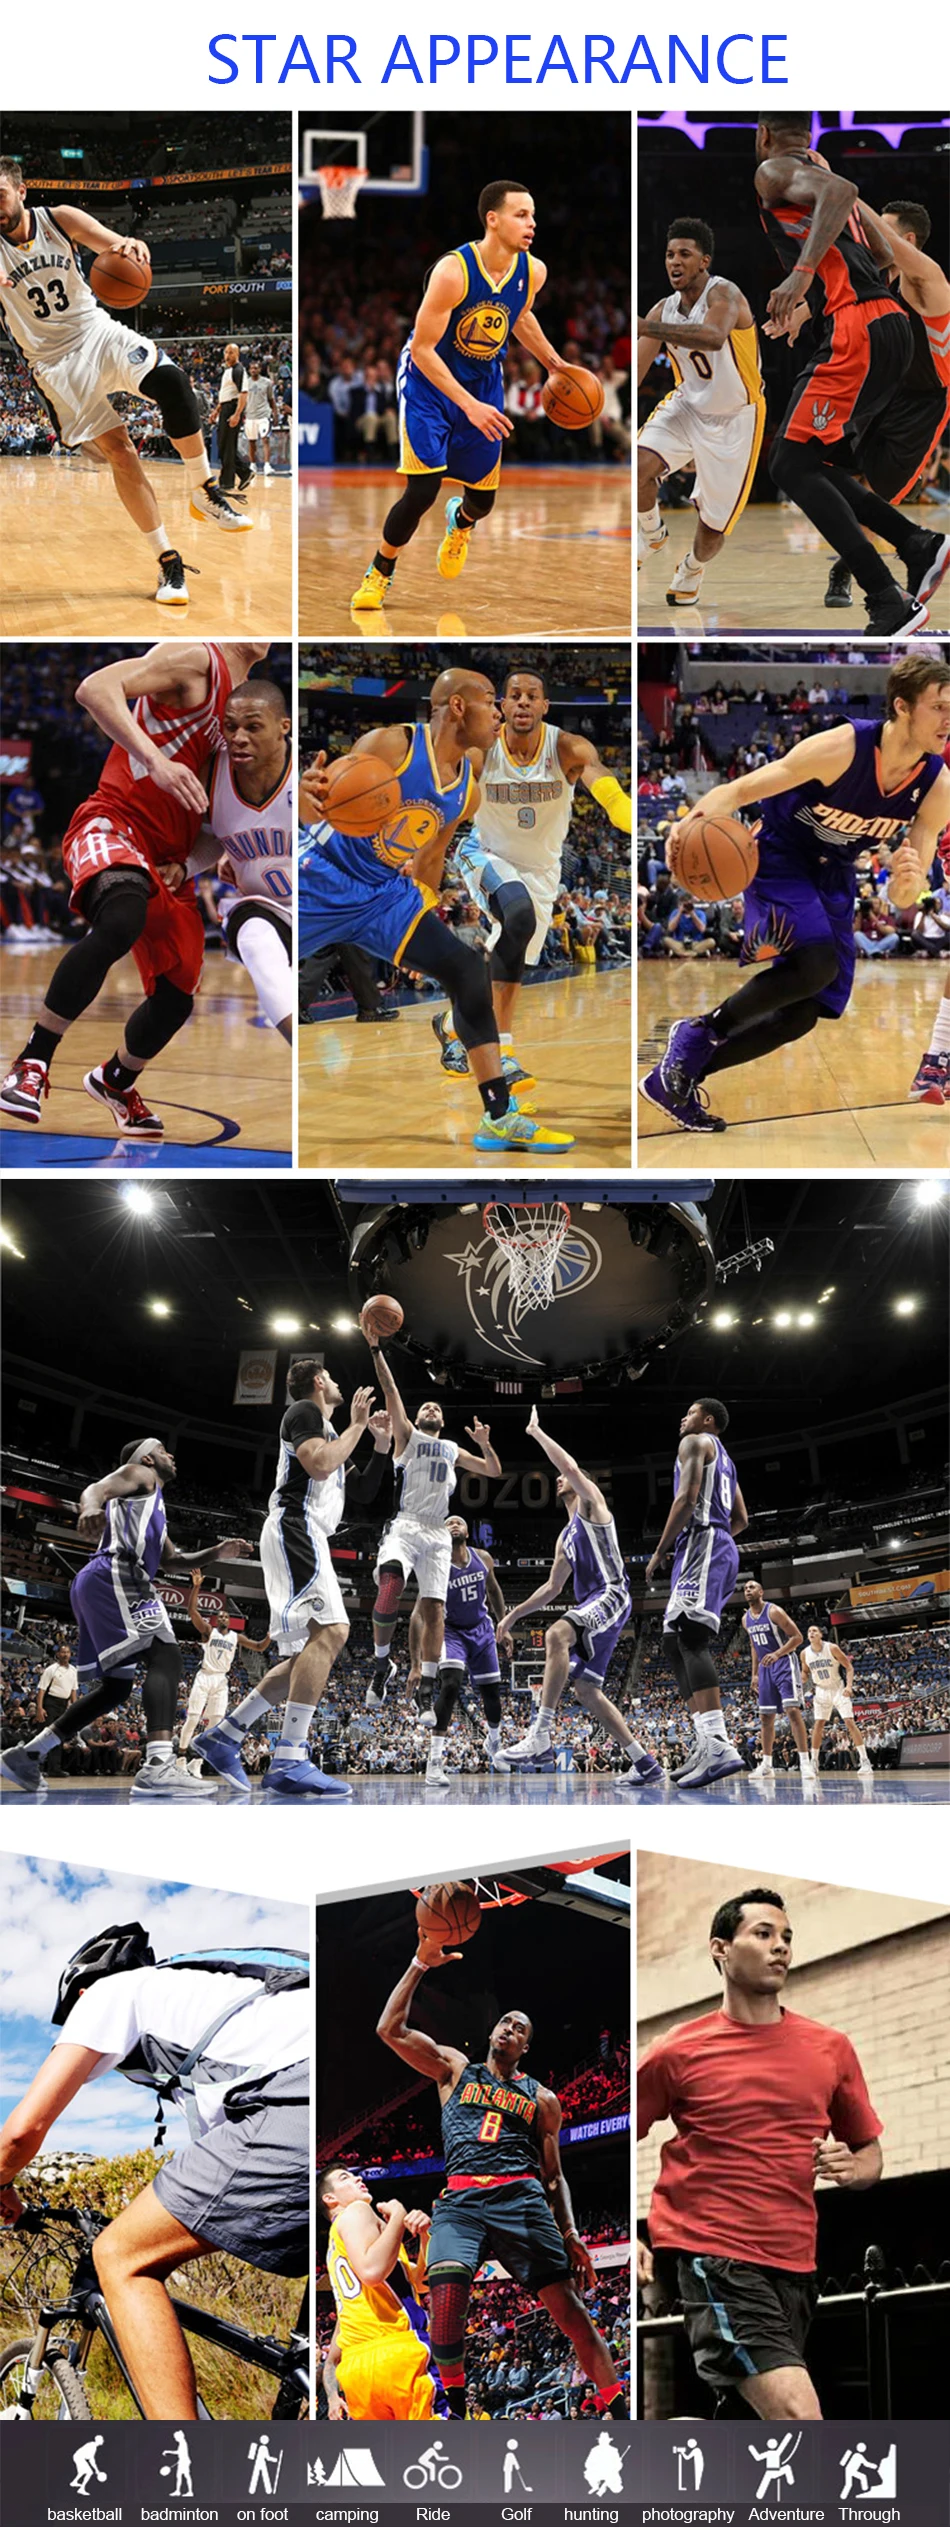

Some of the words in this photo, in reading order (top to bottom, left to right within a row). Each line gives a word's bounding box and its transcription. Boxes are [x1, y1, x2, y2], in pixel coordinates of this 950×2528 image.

[27, 278, 70, 319] 33
[483, 316, 503, 330] 30
[689, 350, 712, 380] 0
[486, 780, 562, 805] NUGGETS
[517, 806, 536, 829] 9
[416, 820, 430, 834] 2
[262, 867, 292, 899] 0
[429, 1461, 448, 1483] 10
[721, 1472, 732, 1511] 8
[873, 1519, 903, 1531] TECHNOLOGY
[904, 1517, 911, 1525] TO
[449, 1570, 484, 1590] KINGS
[460, 1585, 478, 1603] 15
[676, 1589, 700, 1598] SAC
[858, 1584, 912, 1598] SOUTHWEST.COM
[196, 1597, 217, 1611] KIA
[131, 1608, 161, 1620] SAC
[748, 1623, 770, 1634] KINGS
[210, 1639, 234, 1652] MAGIC
[532, 1635, 543, 1647] 13
[752, 1633, 768, 1646] 40
[217, 1650, 223, 1660] 7
[809, 1660, 833, 1670] MAGIC
[817, 1669, 830, 1680] 00
[855, 1709, 882, 1717] HARRIS
[460, 2082, 536, 2125] ATLANTA
[478, 2109, 503, 2143] 8
[570, 2121, 599, 2141] WATCH
[600, 2115, 628, 2134] EVERY
